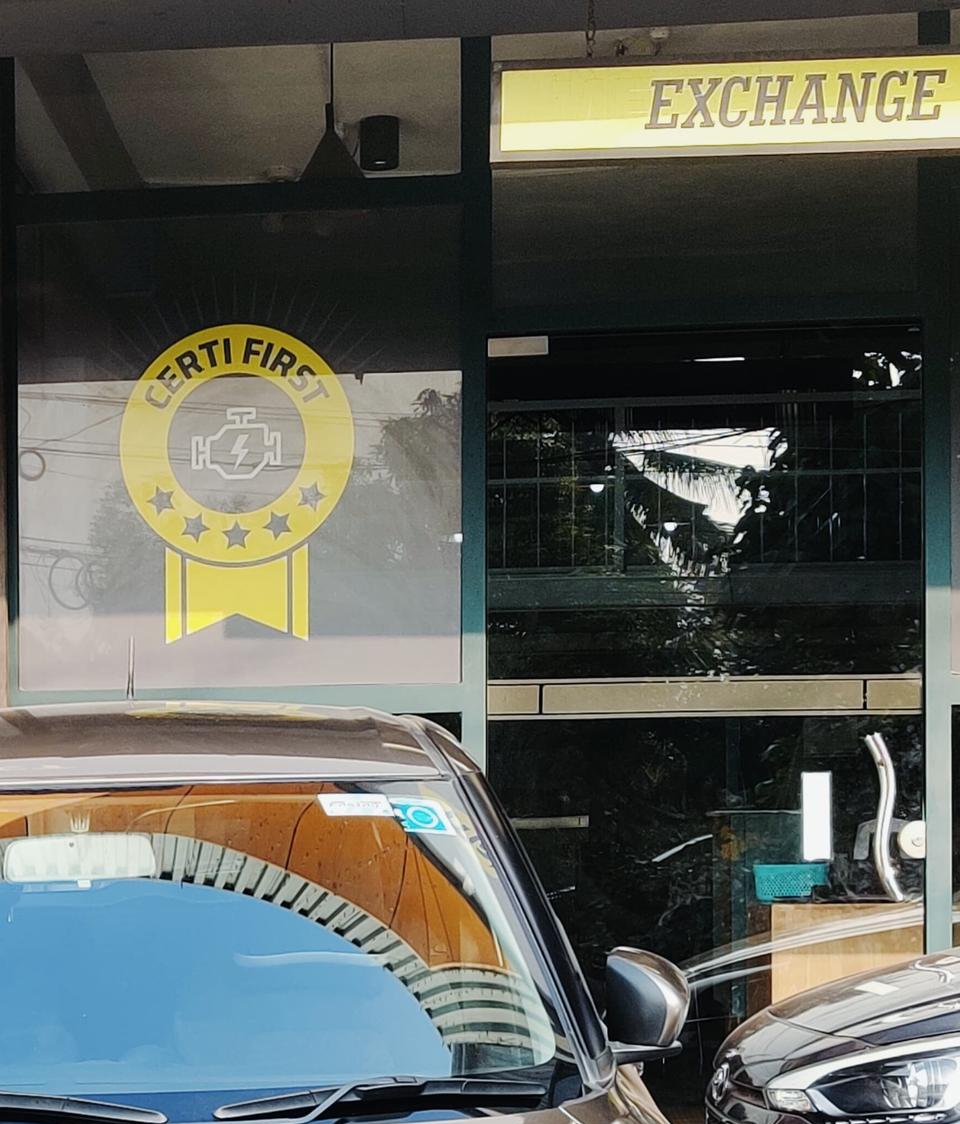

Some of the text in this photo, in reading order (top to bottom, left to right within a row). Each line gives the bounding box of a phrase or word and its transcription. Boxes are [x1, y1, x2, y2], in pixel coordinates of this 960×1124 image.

[645, 70, 947, 129] EXCHANGE
[144, 337, 330, 409] CERTI FIRST
